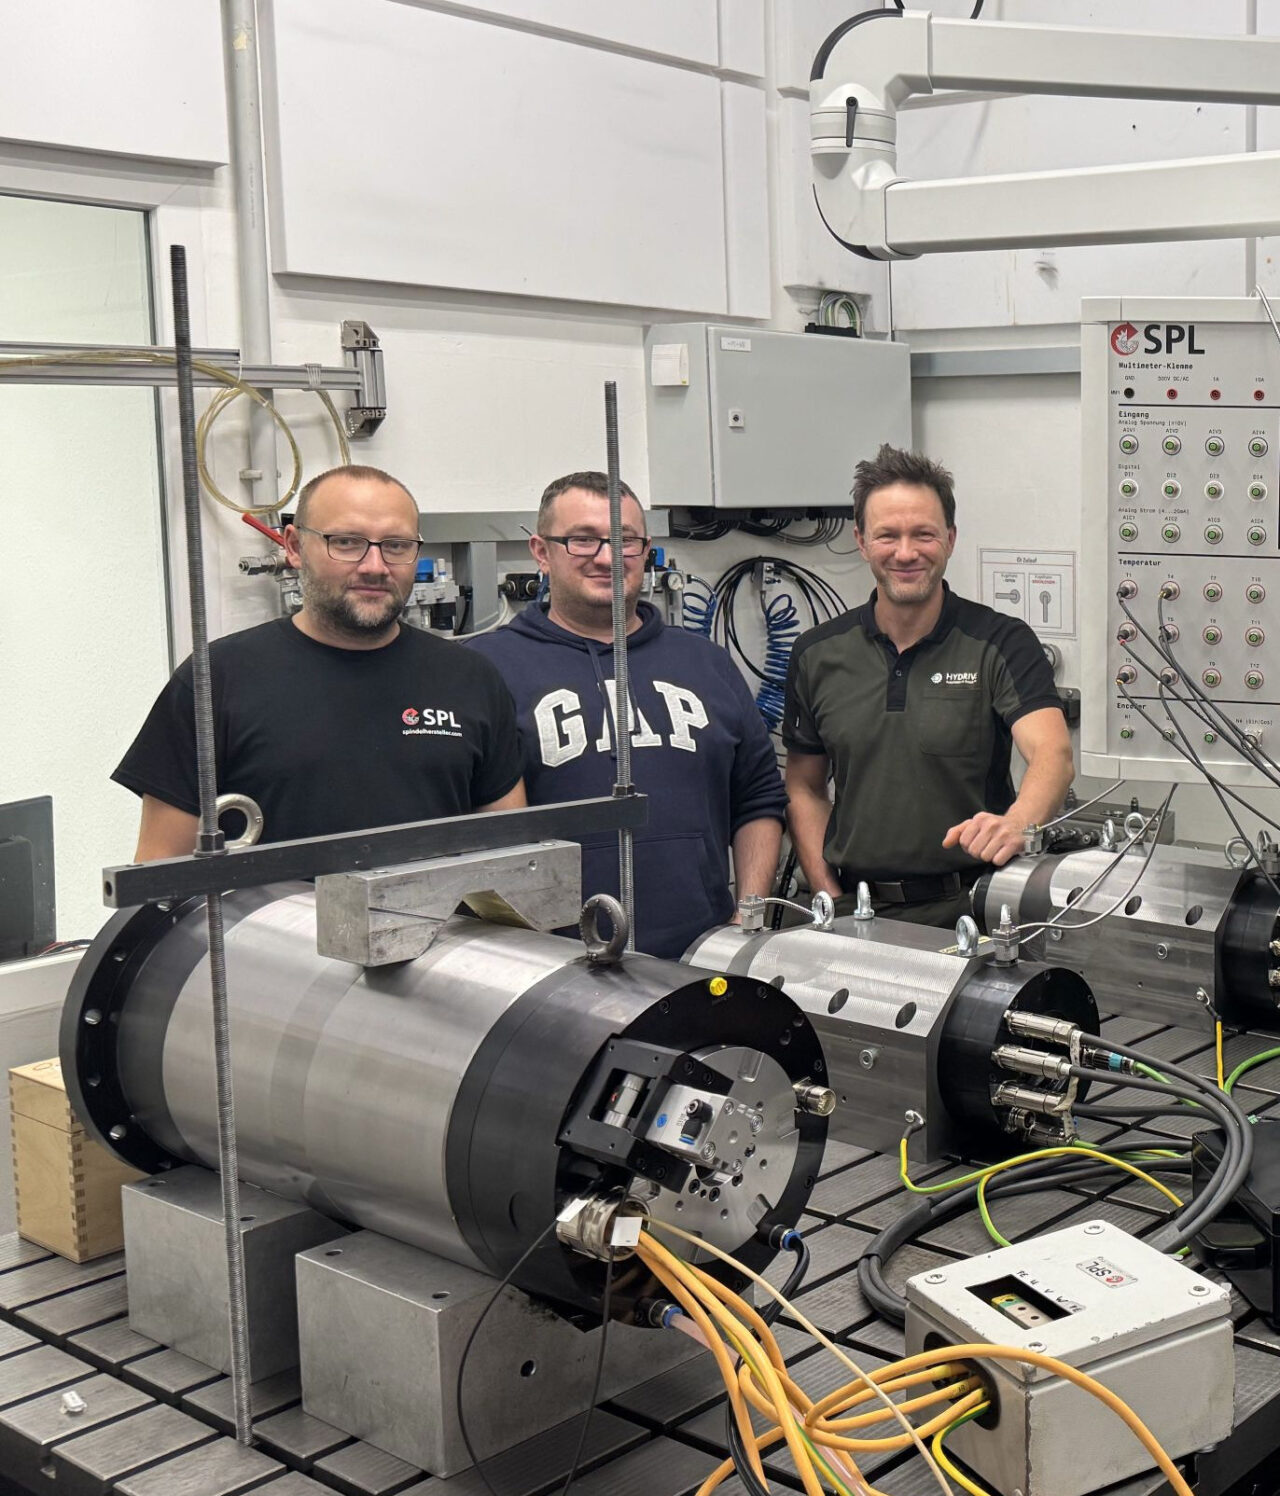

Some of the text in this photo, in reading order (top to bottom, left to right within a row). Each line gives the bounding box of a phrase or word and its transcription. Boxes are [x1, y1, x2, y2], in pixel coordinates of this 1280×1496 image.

[1144, 324, 1206, 355] SPL
[1118, 362, 1194, 370] Multimeter-Klemme
[1118, 411, 1150, 419] Eingang
[1118, 559, 1162, 567] Temperatur
[423, 708, 461, 728] SPL
[534, 679, 709, 767] GAP
[1086, 1260, 1112, 1277] SPL
